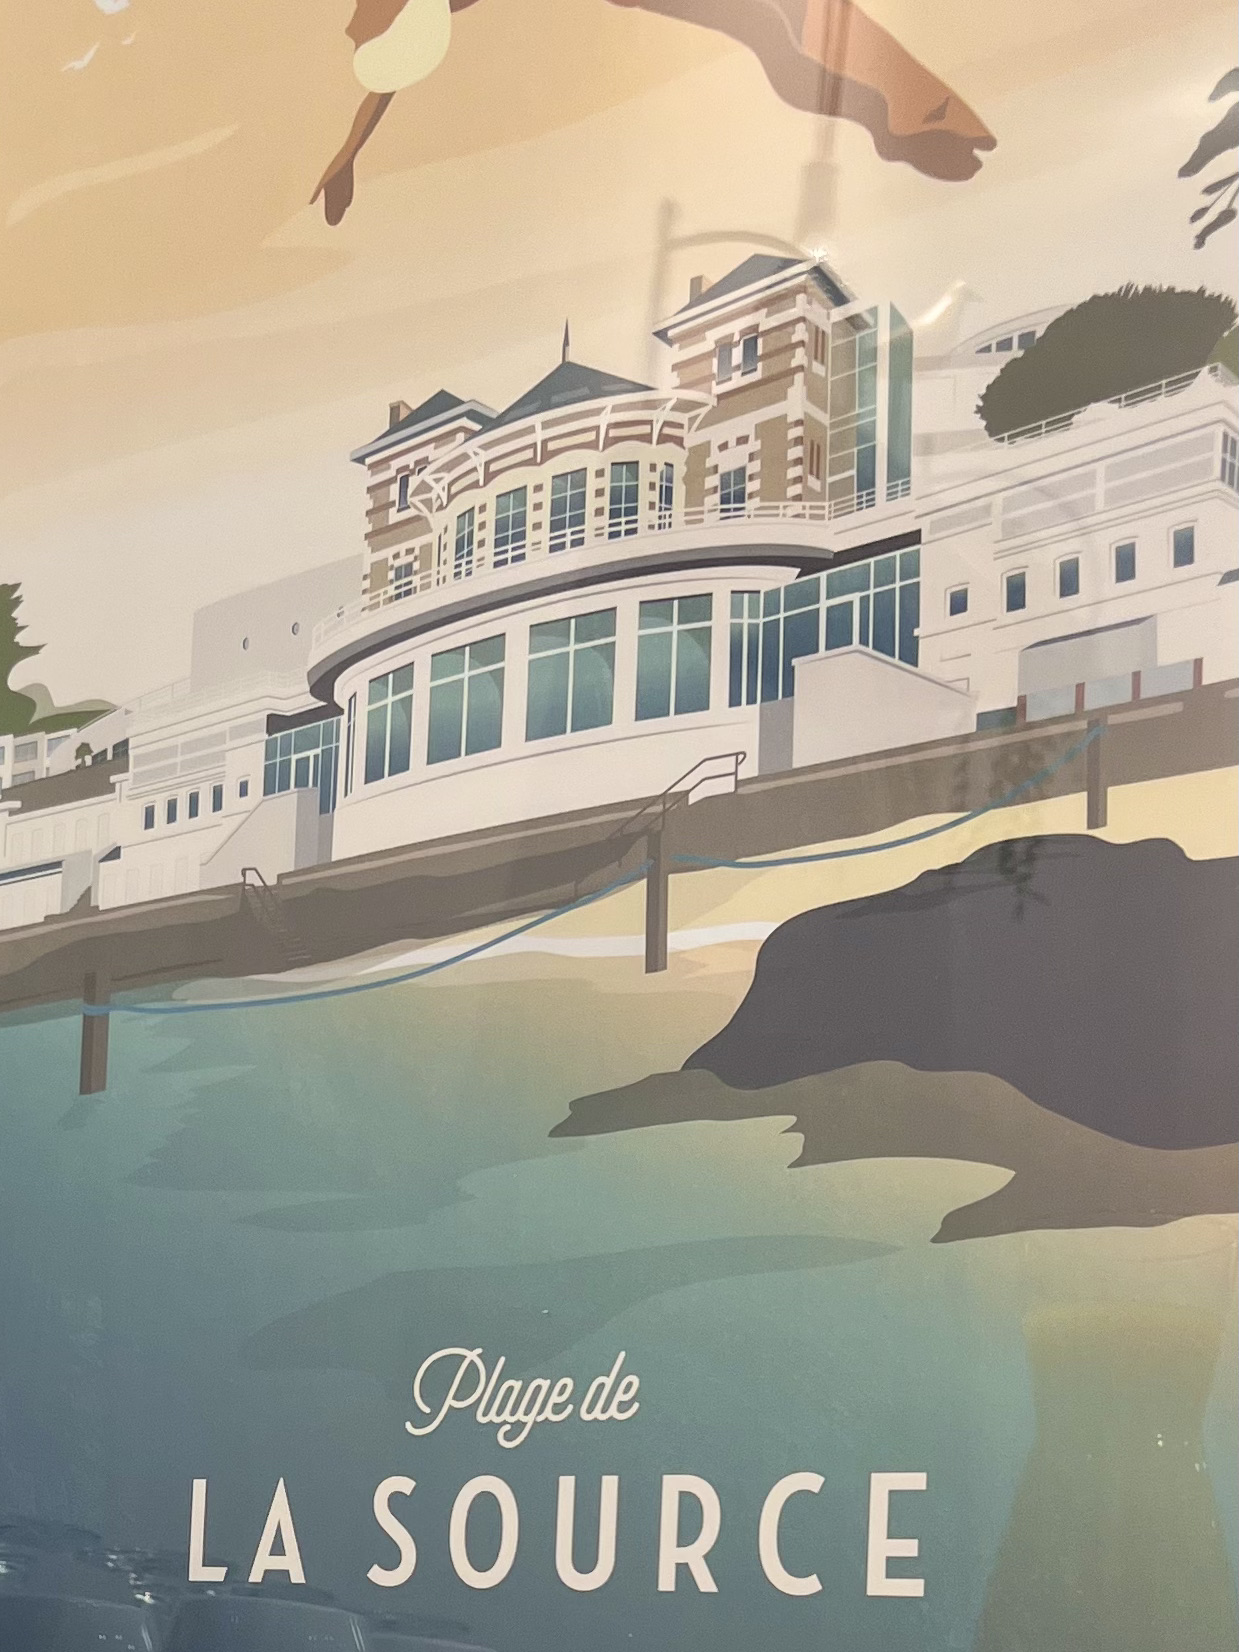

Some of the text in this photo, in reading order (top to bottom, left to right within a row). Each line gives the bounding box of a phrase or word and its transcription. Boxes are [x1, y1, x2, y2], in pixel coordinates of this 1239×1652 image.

[405, 1347, 640, 1449] Plage de
[188, 1471, 928, 1597] LA SOURCE
